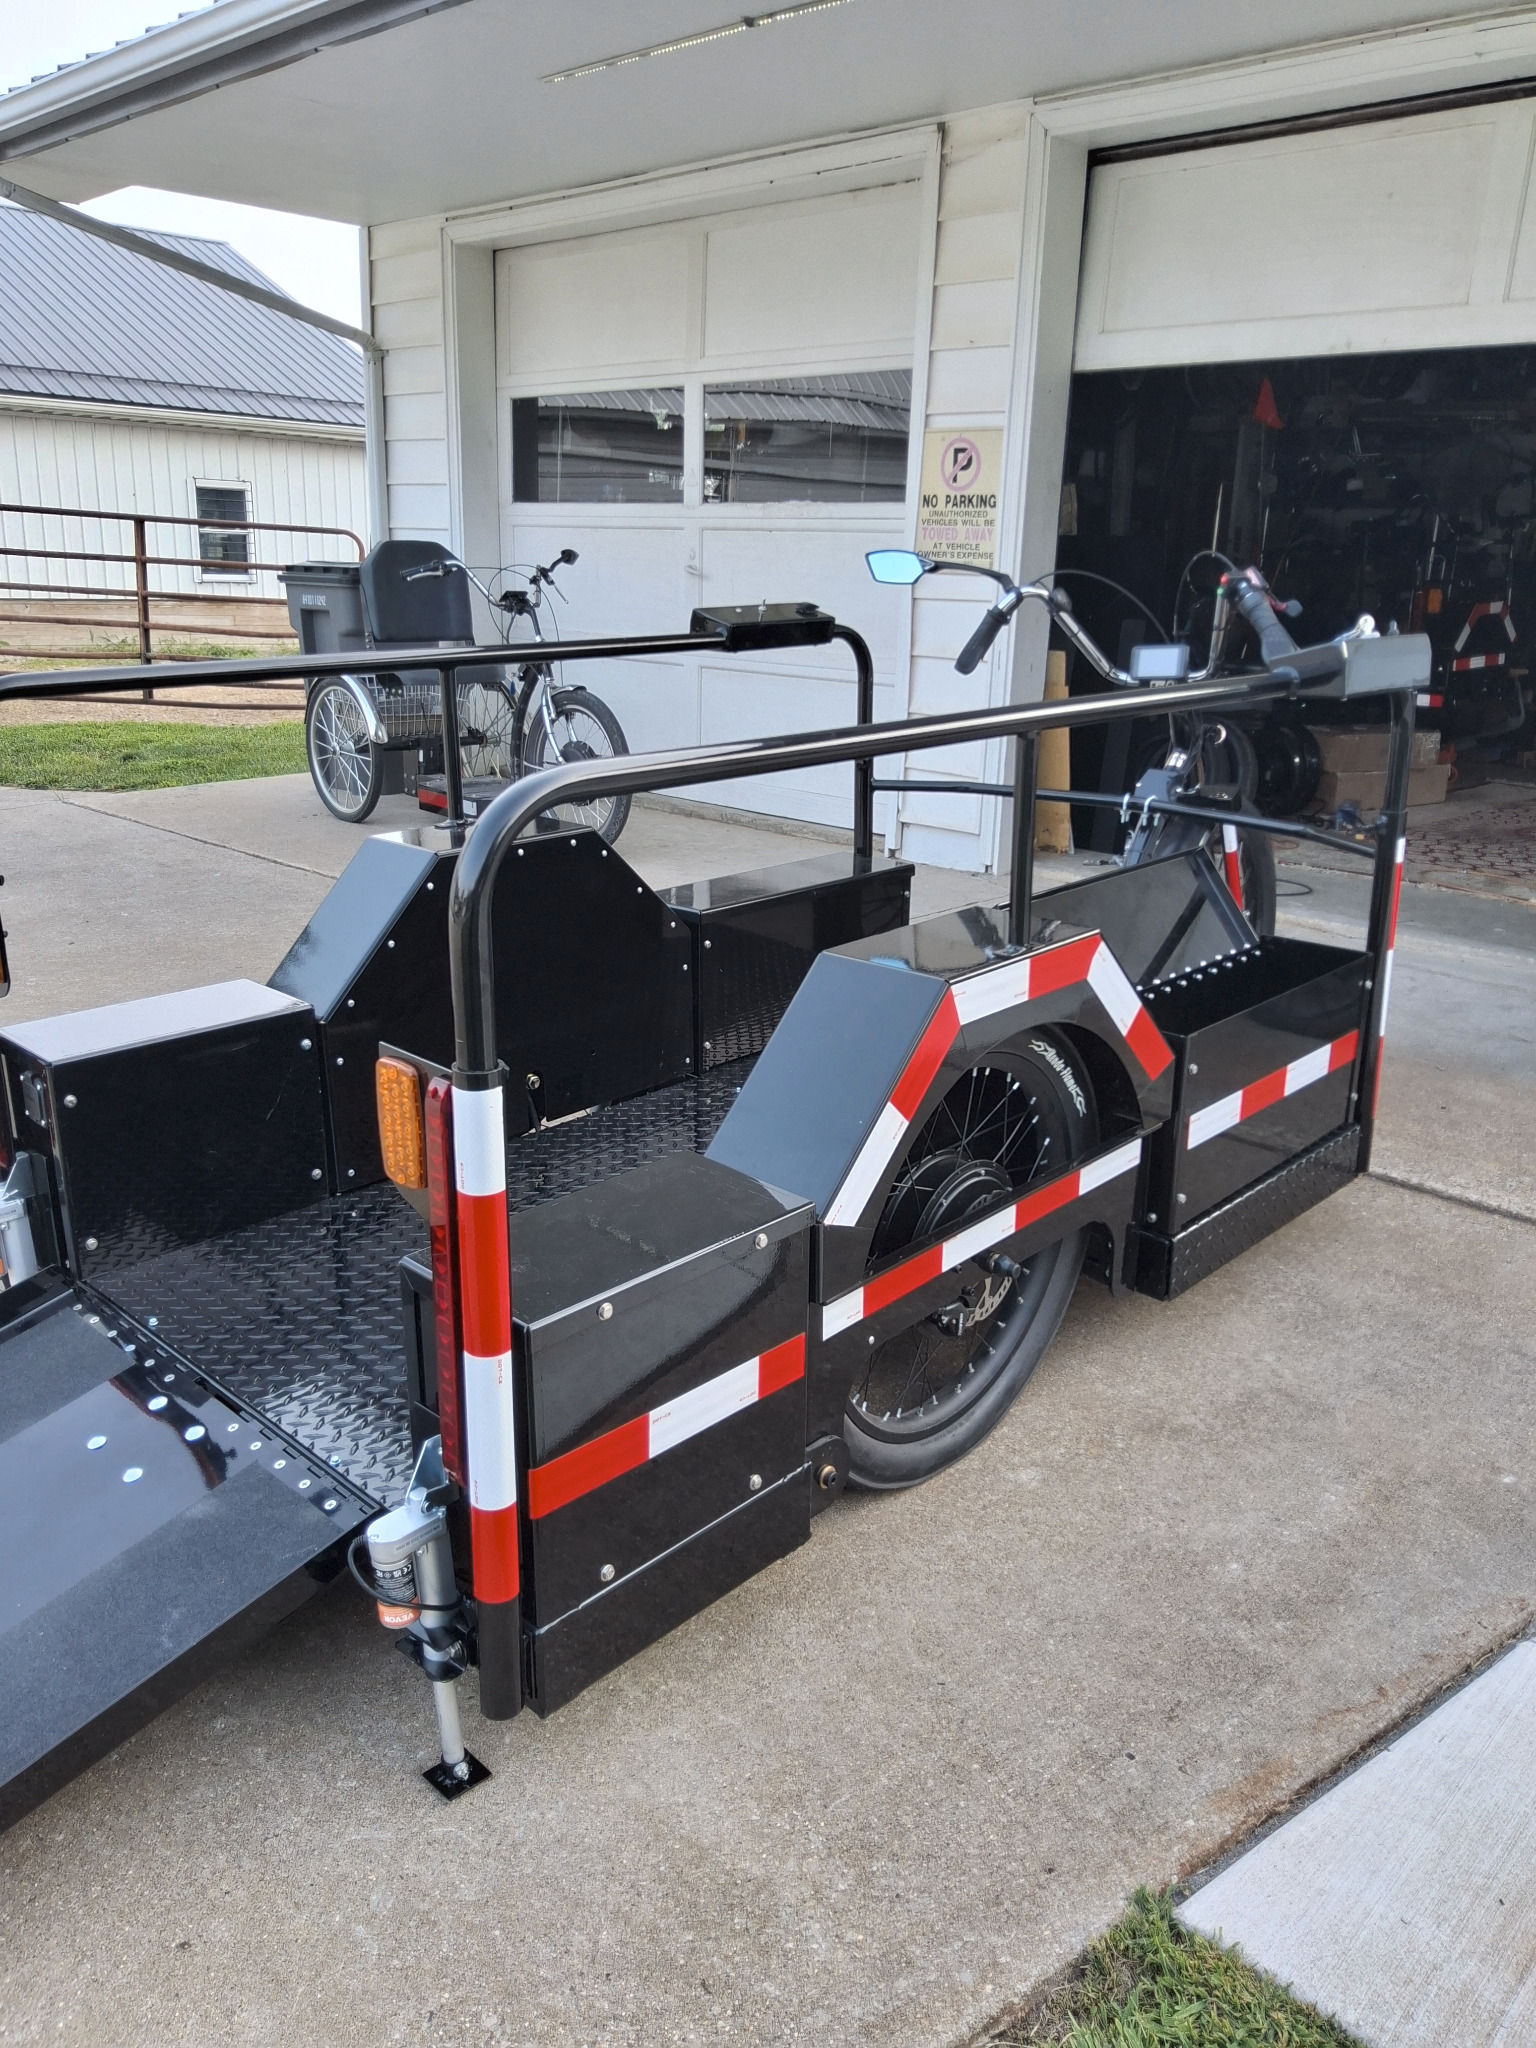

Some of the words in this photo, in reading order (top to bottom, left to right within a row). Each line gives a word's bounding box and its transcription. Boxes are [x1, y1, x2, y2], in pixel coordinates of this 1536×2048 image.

[922, 494, 938, 508] NO
[945, 494, 996, 508] PARKING
[929, 510, 988, 518] UNAUTHORIZED
[921, 518, 958, 526] VEHICLES
[961, 519, 980, 527] WILL
[922, 527, 958, 540] TOWED
[964, 528, 994, 541] AWAY
[946, 543, 980, 551] VEHICLE
[917, 550, 955, 559] OWNER'S
[956, 552, 994, 560] EXPENSE
[384, 1611, 415, 1623] VEVOR
